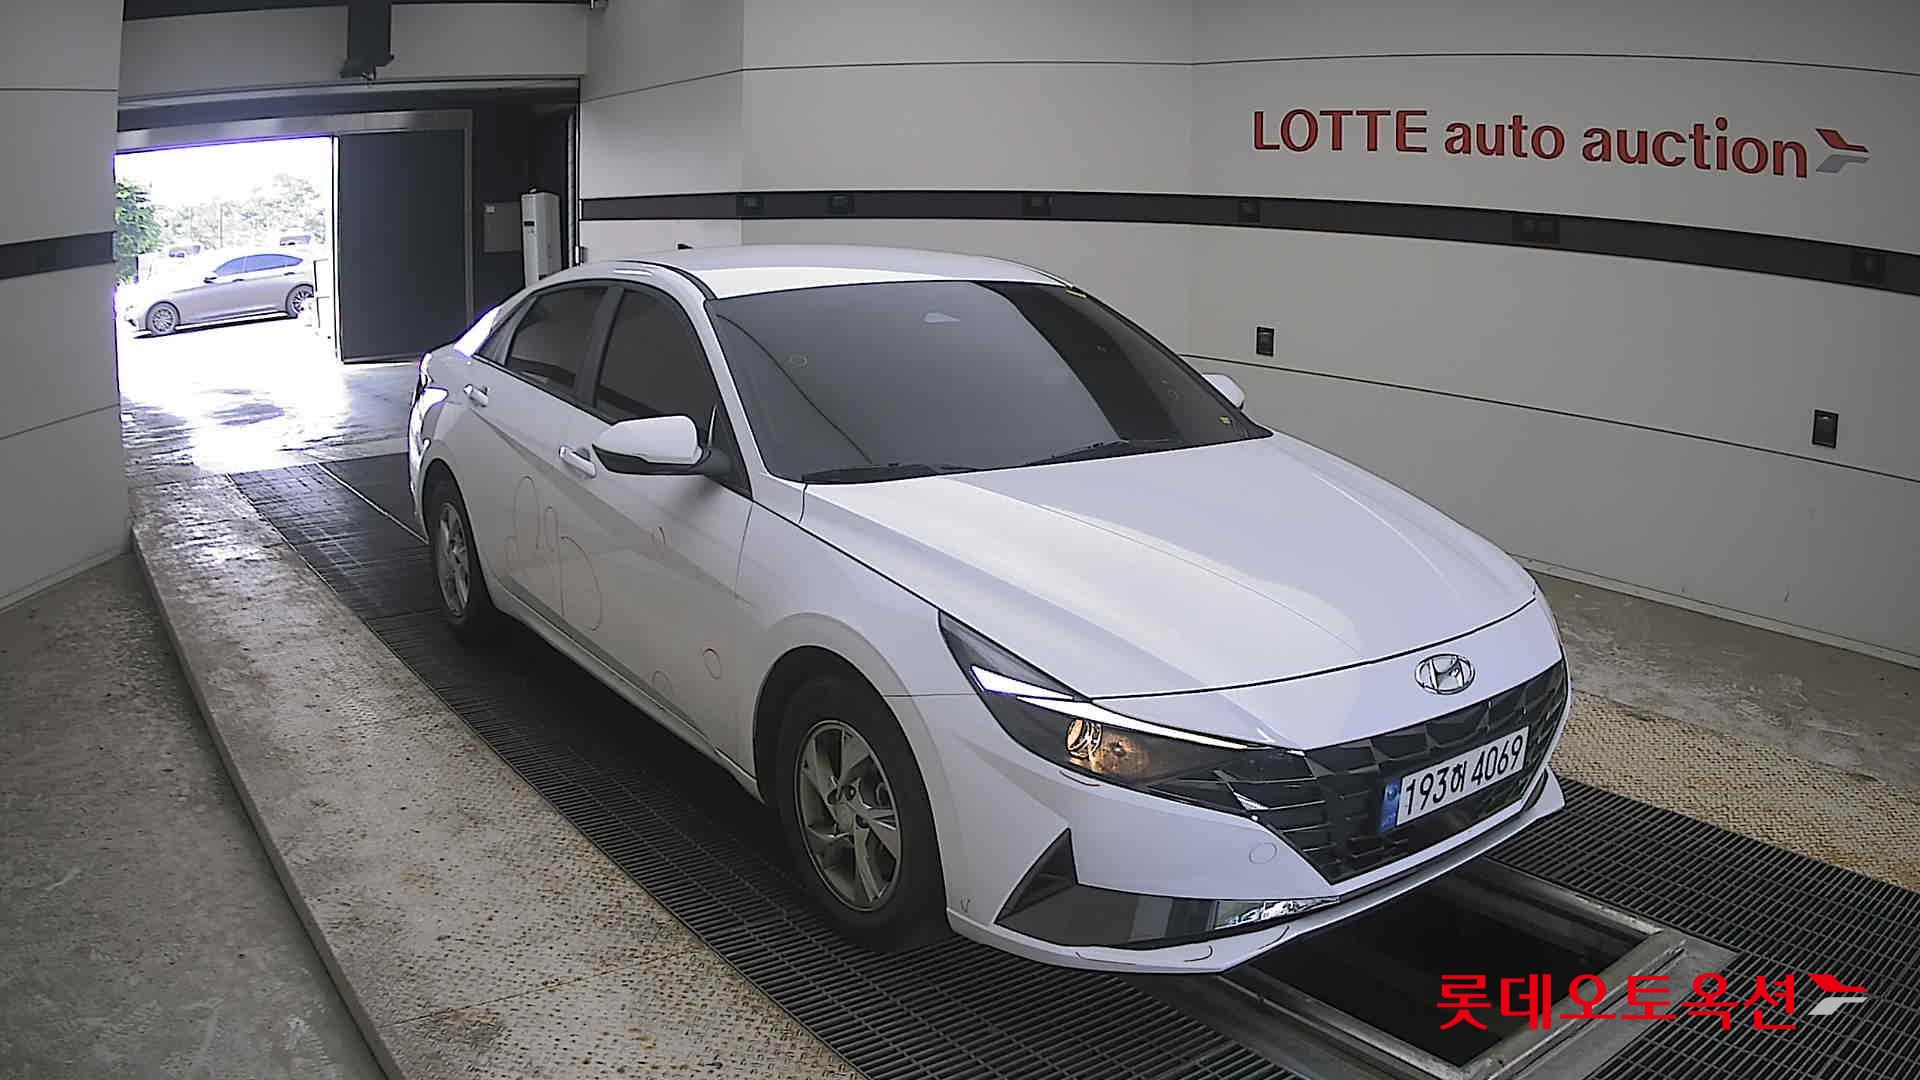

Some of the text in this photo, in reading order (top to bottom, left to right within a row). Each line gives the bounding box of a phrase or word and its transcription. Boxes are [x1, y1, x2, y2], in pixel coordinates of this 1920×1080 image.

[1254, 109, 1809, 178] LOTTE auto auction
[1405, 734, 1524, 815] 193허 4069
